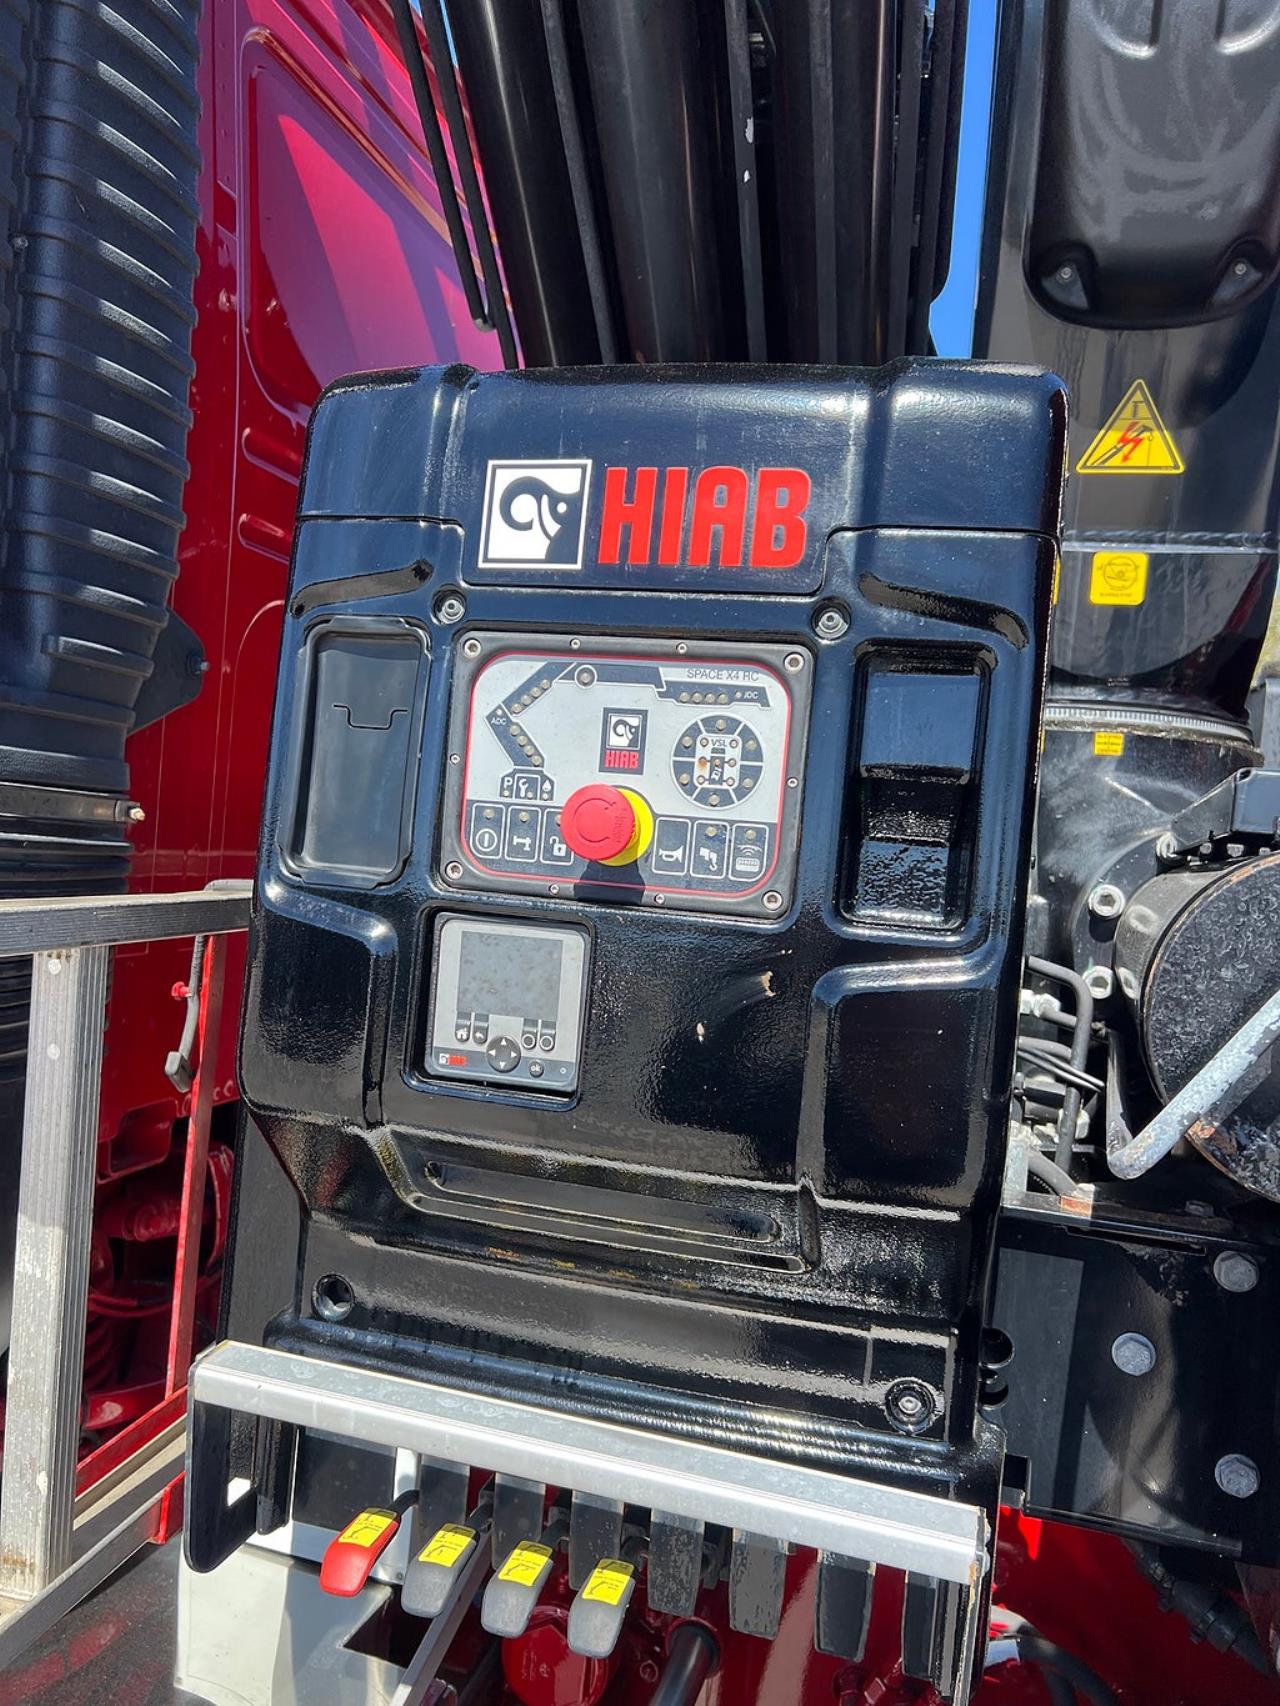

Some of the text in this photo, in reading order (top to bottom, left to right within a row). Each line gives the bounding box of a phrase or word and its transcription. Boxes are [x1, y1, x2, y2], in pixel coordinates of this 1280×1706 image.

[598, 465, 812, 569] HIAB
[687, 669, 723, 681] SPACE
[604, 750, 640, 769] HIAB
[503, 777, 513, 789] P
